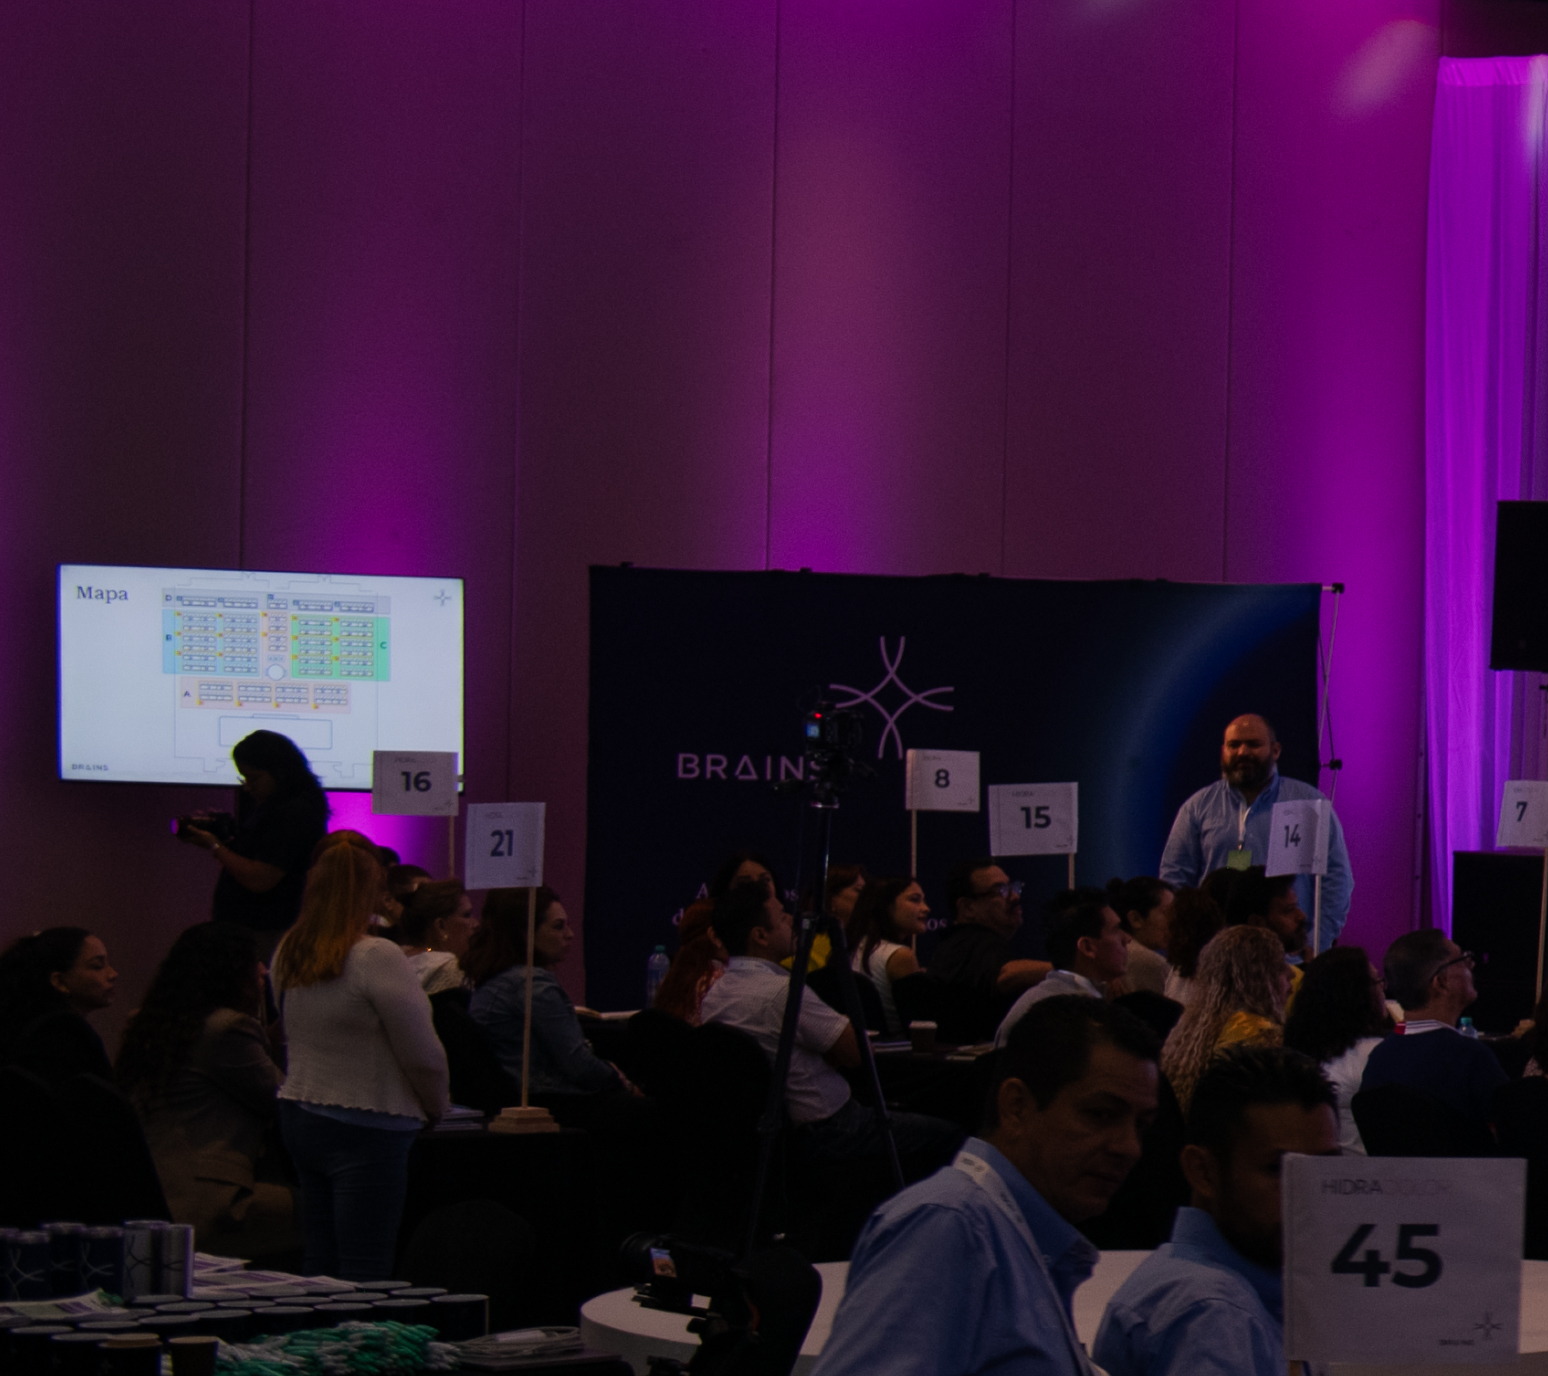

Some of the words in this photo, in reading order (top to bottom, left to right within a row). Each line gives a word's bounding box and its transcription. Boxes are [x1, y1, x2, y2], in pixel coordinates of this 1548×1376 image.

[77, 585, 128, 604] Mapa
[401, 772, 431, 792] 16
[935, 769, 950, 787] 8
[1021, 806, 1051, 828] 15
[1516, 802, 1527, 822] 7
[491, 830, 513, 856] 21
[1285, 824, 1300, 848] 14
[1331, 1223, 1442, 1288] 45
